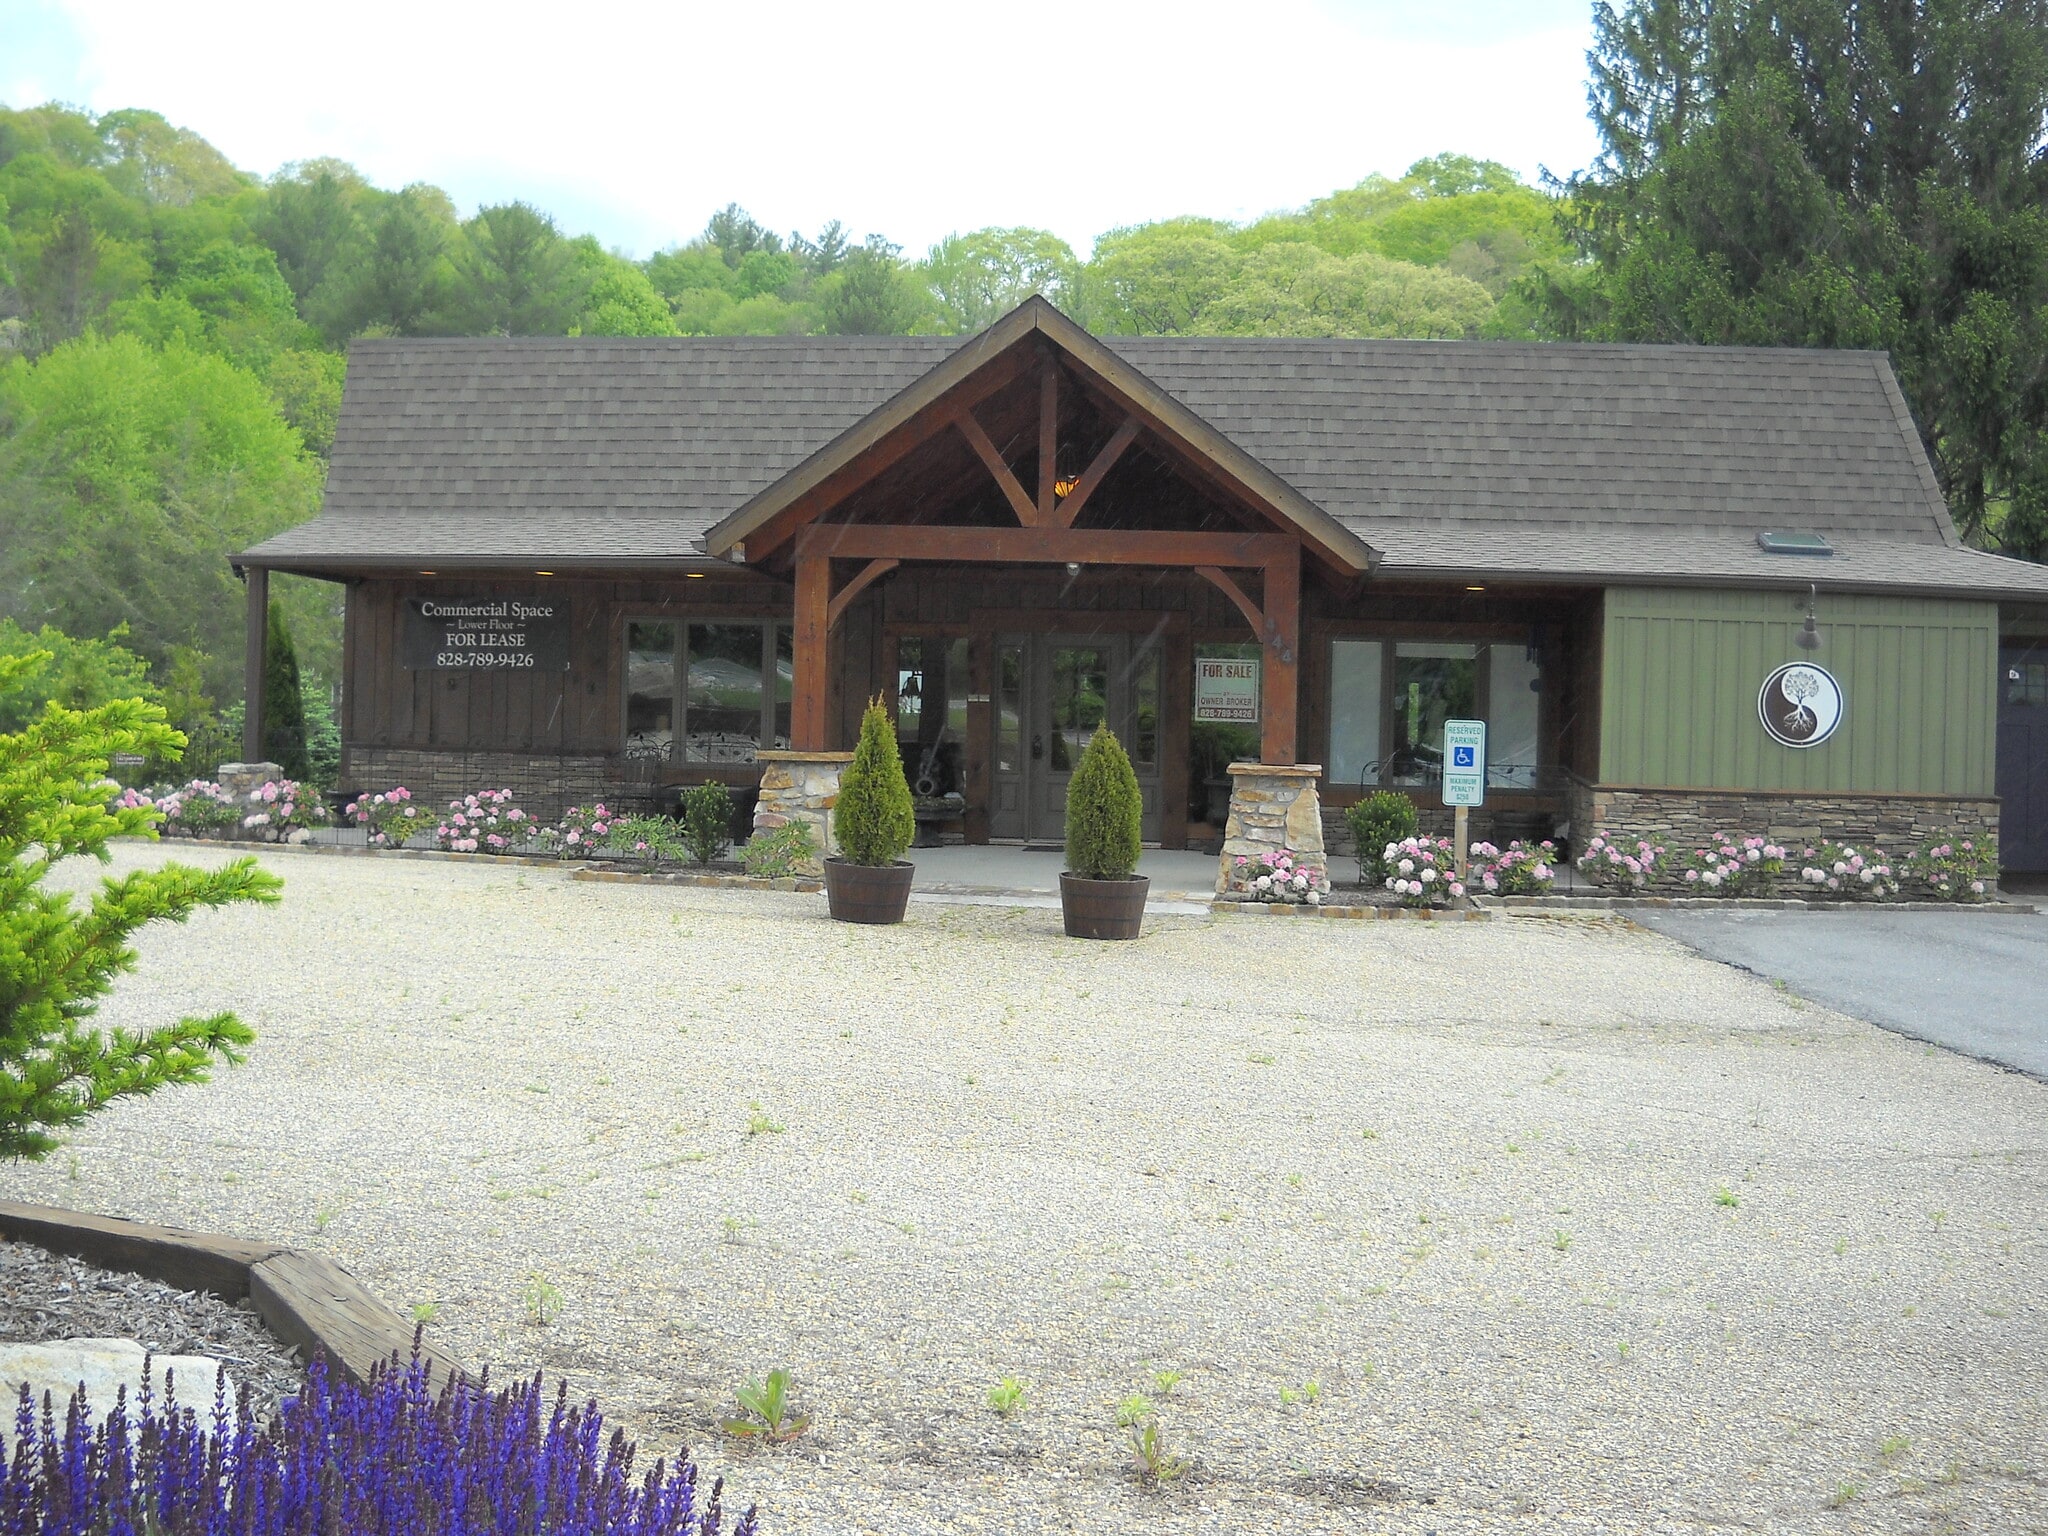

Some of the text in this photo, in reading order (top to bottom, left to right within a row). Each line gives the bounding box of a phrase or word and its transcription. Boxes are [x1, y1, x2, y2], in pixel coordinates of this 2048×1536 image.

[421, 601, 553, 619] Commercial Space
[458, 619, 514, 630] Lower Floor
[446, 633, 526, 646] FOR LEASE
[437, 653, 534, 667] 828-789-9426
[1202, 664, 1252, 678] FOR SALE
[1201, 697, 1252, 706] OWNER BROKER
[1200, 709, 1252, 718] 828-789-9426
[1448, 726, 1481, 735] RESERVED
[1450, 736, 1479, 745] PARKING
[1449, 777, 1477, 785] MAXIMUM
[1450, 785, 1475, 793] PENALTY
